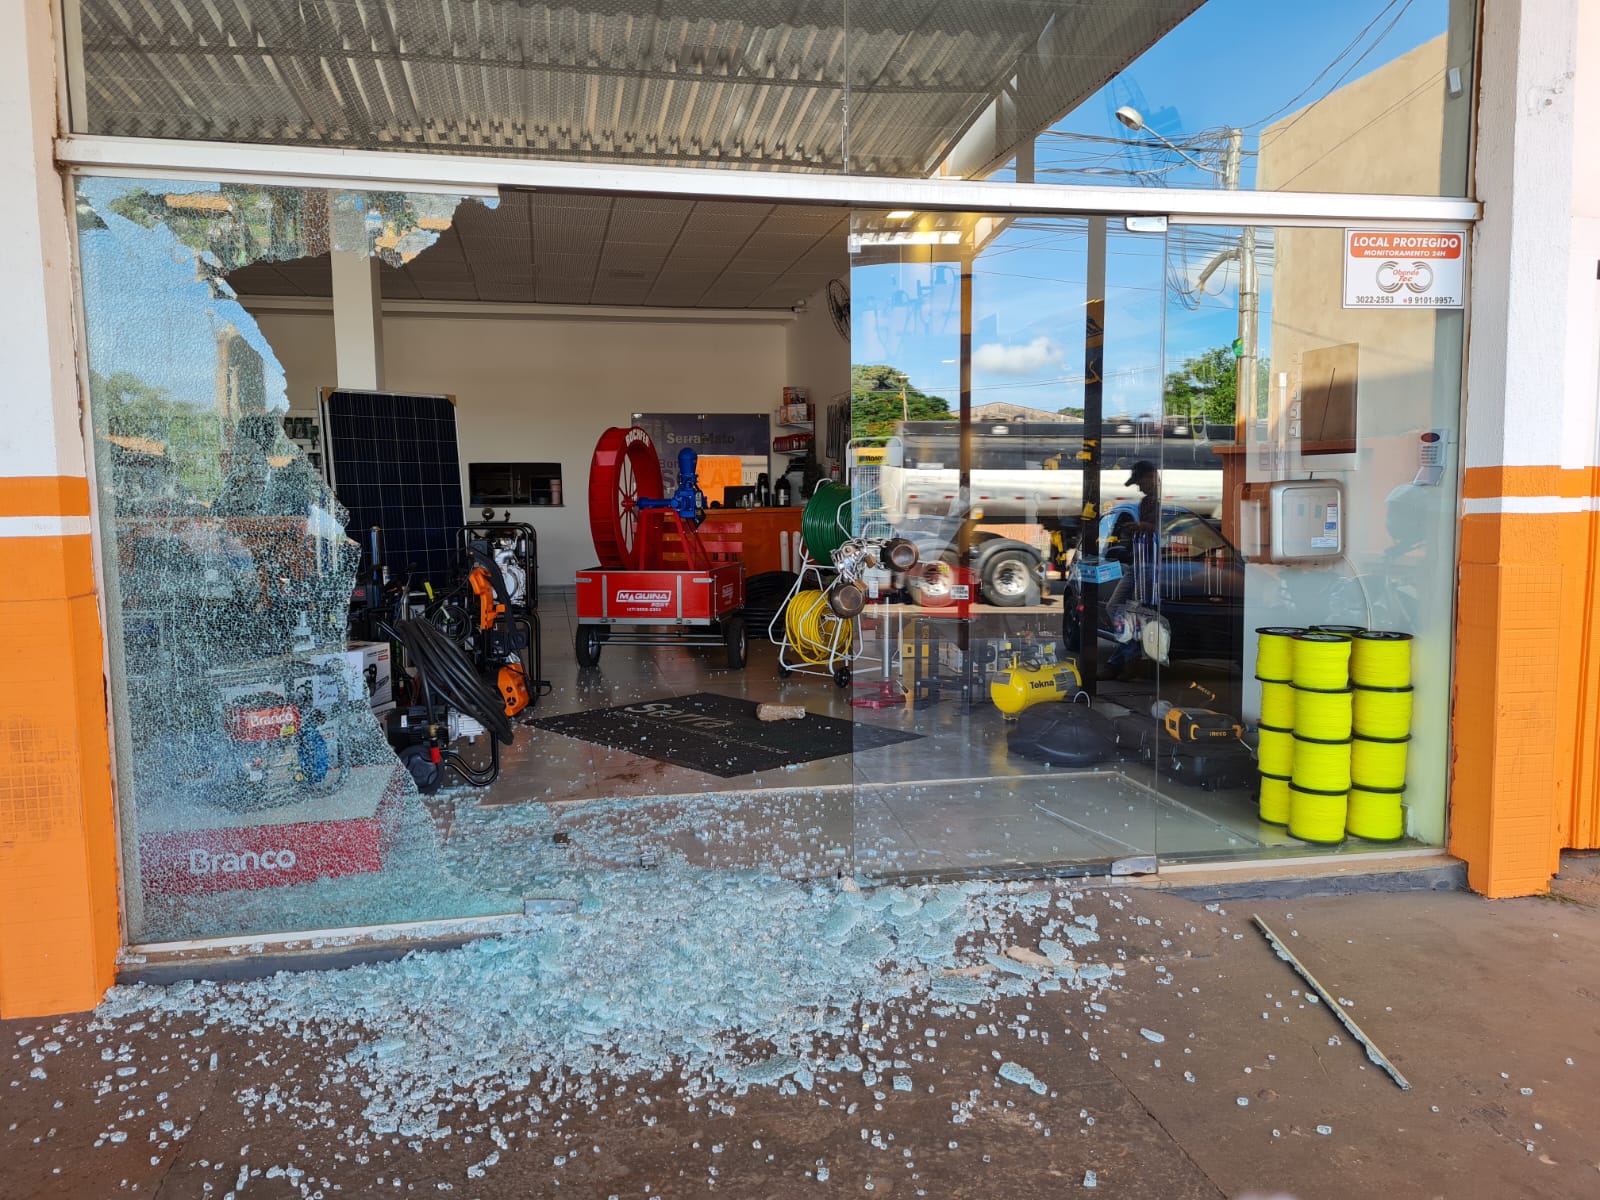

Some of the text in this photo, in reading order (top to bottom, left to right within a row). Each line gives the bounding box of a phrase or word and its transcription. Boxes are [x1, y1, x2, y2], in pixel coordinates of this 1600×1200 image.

[1353, 236, 1458, 249] LOCAL PROTEGIDO
[1363, 249, 1430, 257] MONITORAMENTO
[1355, 295, 1395, 304] 3022-2553
[1414, 296, 1453, 304] 9101-9957
[1029, 679, 1055, 690] Tekna
[249, 712, 294, 728] Branco
[189, 848, 297, 874] Branco
